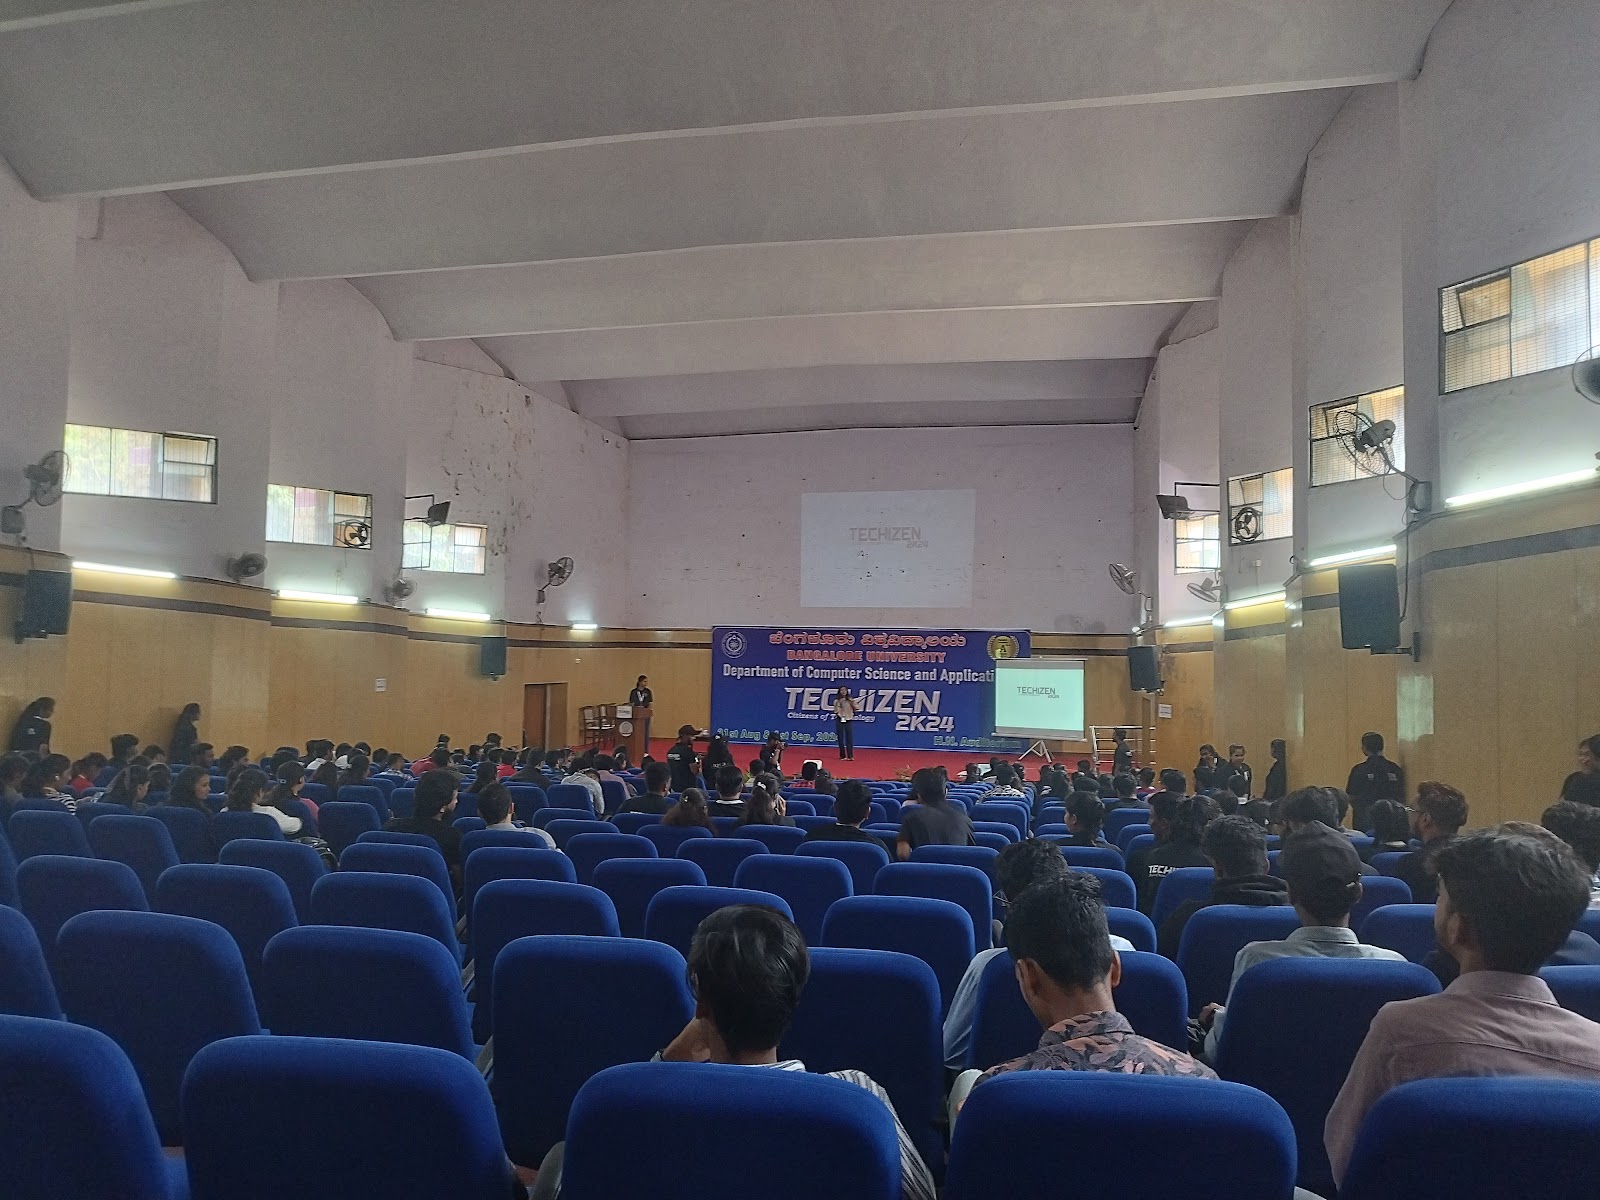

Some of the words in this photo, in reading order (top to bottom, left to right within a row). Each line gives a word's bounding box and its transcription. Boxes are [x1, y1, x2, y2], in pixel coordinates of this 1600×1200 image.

[849, 527, 921, 541] TECHIZEN
[787, 650, 862, 661] BANGALORE
[866, 651, 946, 663] UNIVERSITY
[723, 664, 789, 679] Department
[792, 666, 804, 678] of
[806, 666, 862, 681] Computer
[865, 667, 911, 680] Science
[914, 669, 937, 681] and
[940, 669, 995, 684] Applicati
[787, 712, 818, 720] Citizens
[820, 713, 830, 721] of
[895, 715, 954, 732] 2K24
[740, 729, 760, 741] Aug
[791, 731, 814, 743] Sep,
[1148, 865, 1176, 874] TECH
